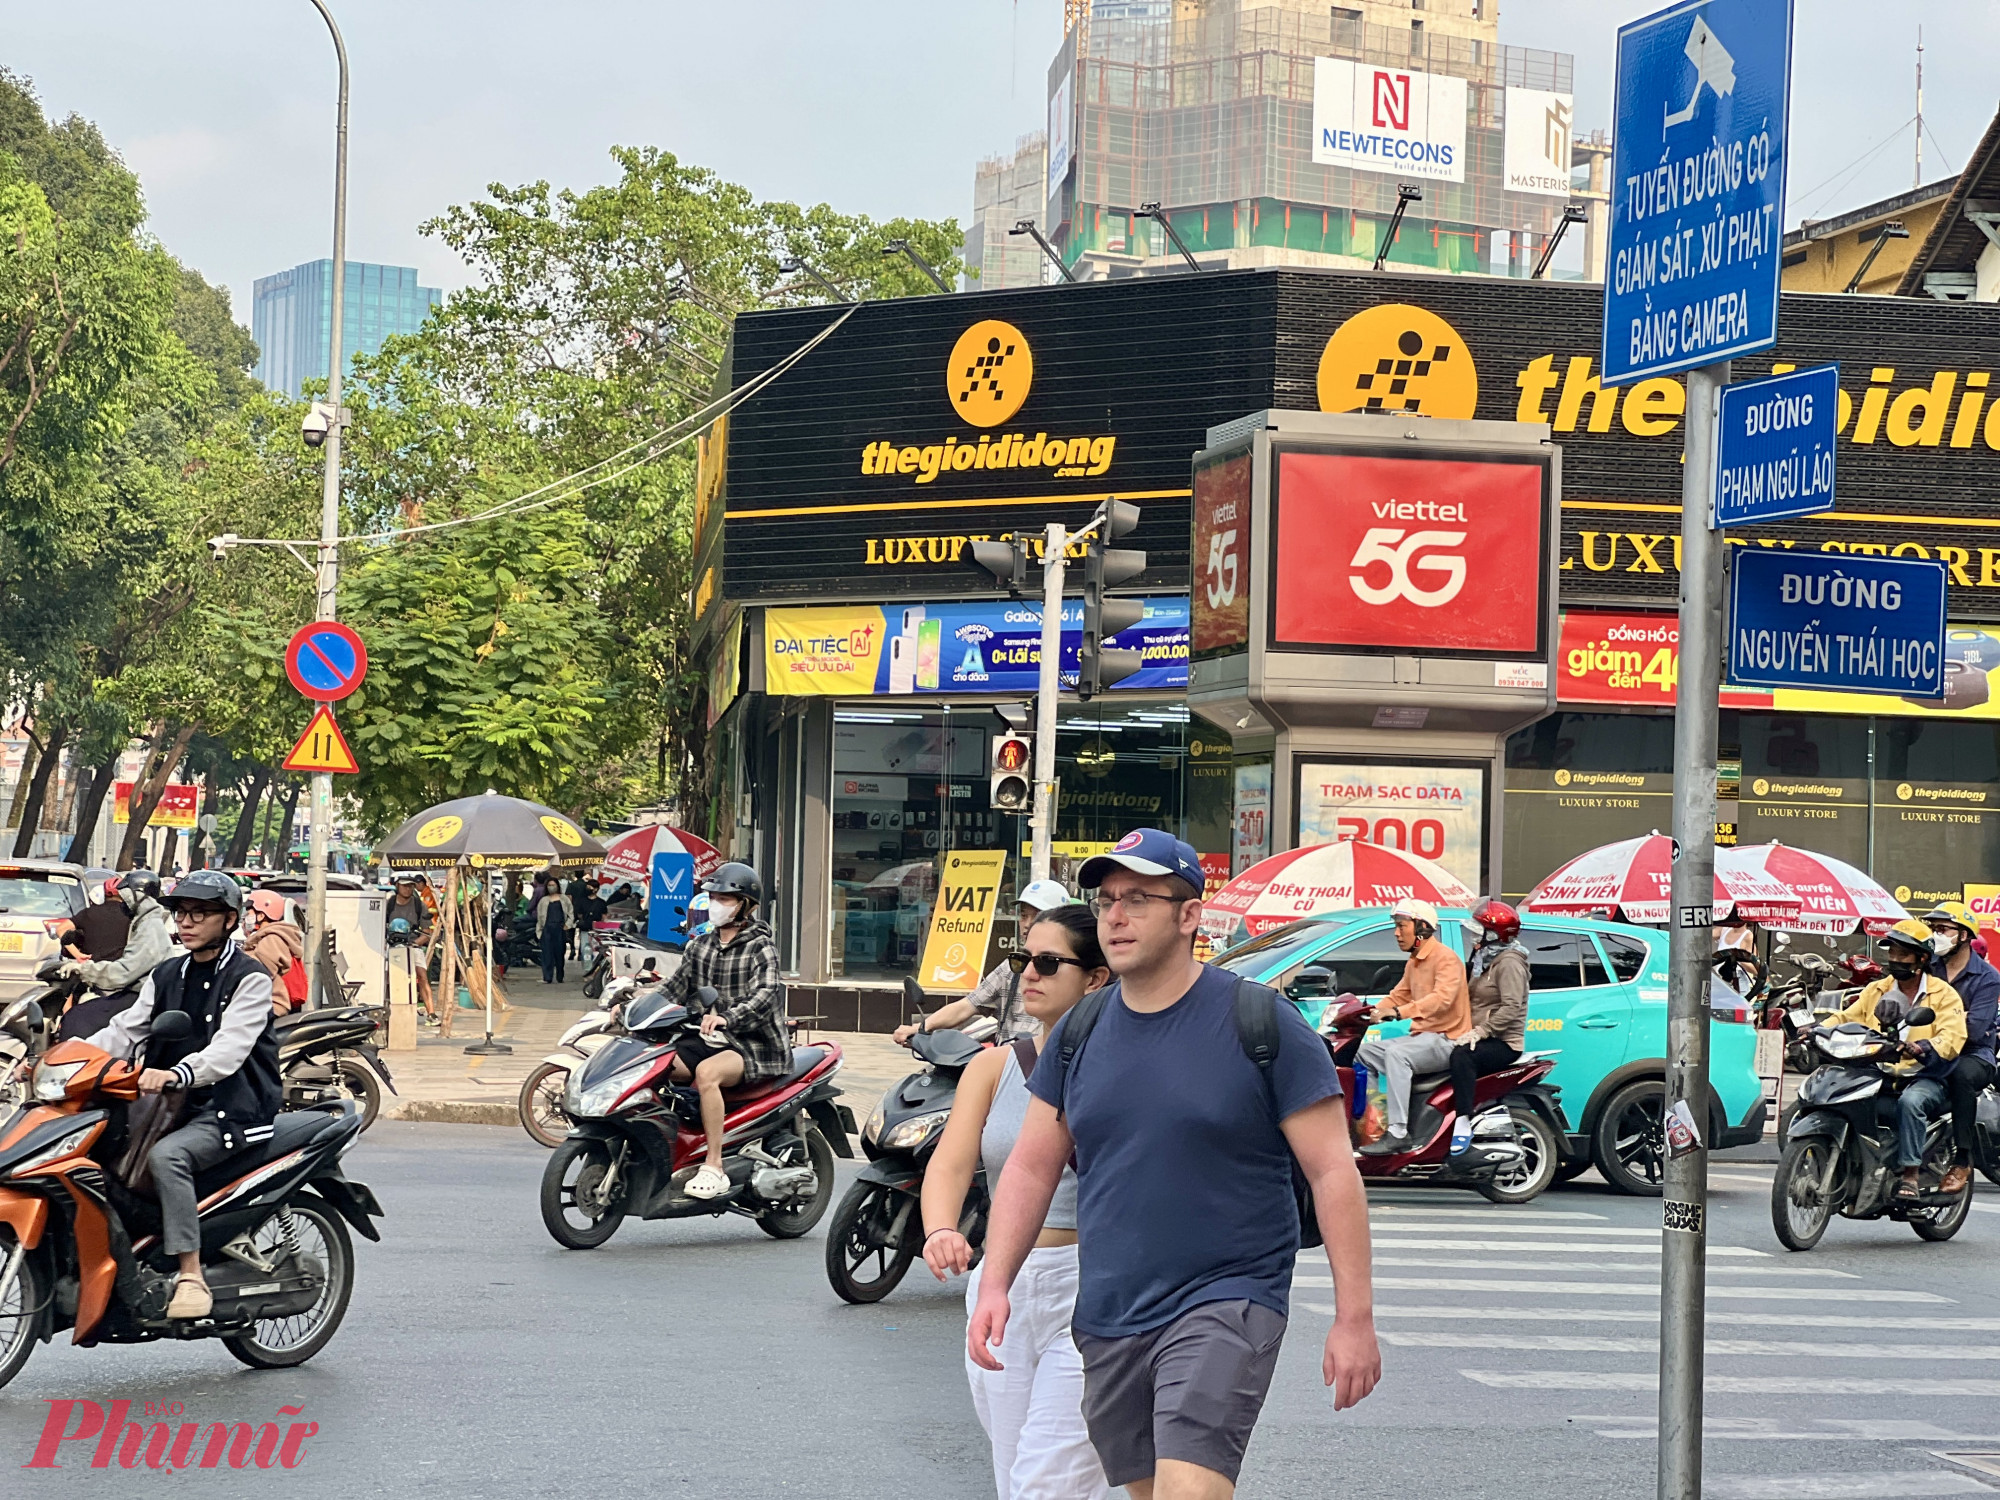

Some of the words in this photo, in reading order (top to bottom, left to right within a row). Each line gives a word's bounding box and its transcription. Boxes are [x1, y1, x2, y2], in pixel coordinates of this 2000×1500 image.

[1323, 128, 1453, 165] NEWTECONS
[1627, 146, 1679, 224] TUYẾN
[1683, 139, 1743, 203] ĐƯỜNG
[1746, 117, 1770, 182] CÓ
[1615, 229, 1656, 296] GIÁM
[1660, 224, 1697, 283] SÁT,
[1699, 202, 1725, 272] XỬ
[1727, 204, 1774, 271] PHẠT
[1630, 296, 1677, 366] BẰNG
[1681, 288, 1748, 352] CAMERA
[1745, 393, 1814, 436] ĐƯỜNG
[861, 432, 1116, 483] thegioididong
[1721, 462, 1764, 513] PHẠM
[1767, 447, 1800, 503] NGŨ
[1802, 442, 1832, 497] LÃO
[1212, 500, 1237, 525] viettel
[1371, 499, 1468, 522] viettel
[1206, 529, 1238, 610] 5G
[1349, 527, 1467, 608] 5G
[1780, 570, 1902, 611] ĐƯỜNG
[1004, 610, 1043, 626] Galaxy
[954, 624, 994, 639] Awesome
[1608, 624, 1646, 642] ĐỒNG
[1648, 624, 1668, 642] HỒ
[774, 639, 804, 656] ĐẠI
[808, 634, 848, 655] TIỆC
[854, 637, 866, 651] AI
[1004, 639, 1030, 647] Samsung
[1009, 648, 1028, 664] Lãi
[1567, 642, 1642, 678] giảm
[1739, 619, 1829, 676] NGUYỄN
[1836, 627, 1888, 678] THÁI
[1891, 639, 1936, 687] HỌC
[1964, 650, 1982, 664] JBL
[1608, 669, 1641, 690] đến
[1642, 653, 1678, 692] 4
[1193, 768, 1228, 777] LUXURY
[1573, 774, 1644, 786] thegioididong
[1320, 784, 1373, 800] TRẠM
[1378, 786, 1412, 801] SẠC
[1416, 786, 1462, 800] DATA
[1771, 784, 1842, 797] thegioididong
[1914, 788, 1986, 802] thegioididong
[1560, 798, 1603, 807] LUXURY
[1606, 799, 1640, 808] STORE
[1757, 808, 1801, 818] LUXURY
[1804, 809, 1838, 819] STORE
[1901, 812, 1944, 822] LUXURY
[1947, 814, 1981, 824] STORE
[1240, 810, 1264, 846] 300
[1074, 846, 1088, 854] 8:00
[392, 858, 426, 867] LUXURY
[430, 858, 456, 867] STORE
[486, 857, 548, 866] thegioididong
[560, 858, 584, 866] LUXURY
[584, 856, 604, 865] STORE
[608, 855, 642, 869] LAPTOP
[1563, 875, 1584, 884] ĐẶC
[1586, 874, 1618, 884] QUYỀN
[1268, 882, 1297, 898] ĐIỆN
[1300, 886, 1352, 900] THOẠI
[1371, 884, 1414, 898] THAY
[1540, 886, 1581, 900] SINH
[1582, 882, 1620, 899] VIÊN
[1724, 882, 1756, 898] ĐIỆN
[1750, 884, 1790, 898] THOẠI
[1796, 882, 1834, 894] QUYỀN
[945, 886, 994, 912] VAT
[1808, 896, 1848, 912] VIÊN
[1913, 891, 1962, 902] thegioidi
[1294, 900, 1316, 911] CŨ
[1626, 909, 1642, 919] 136
[937, 918, 984, 932] Refund
[1784, 920, 1808, 930] THÊM
[1810, 918, 1827, 932] ĐẾN
[1830, 919, 1854, 933] 10%
[1527, 1018, 1564, 1031] 2088
